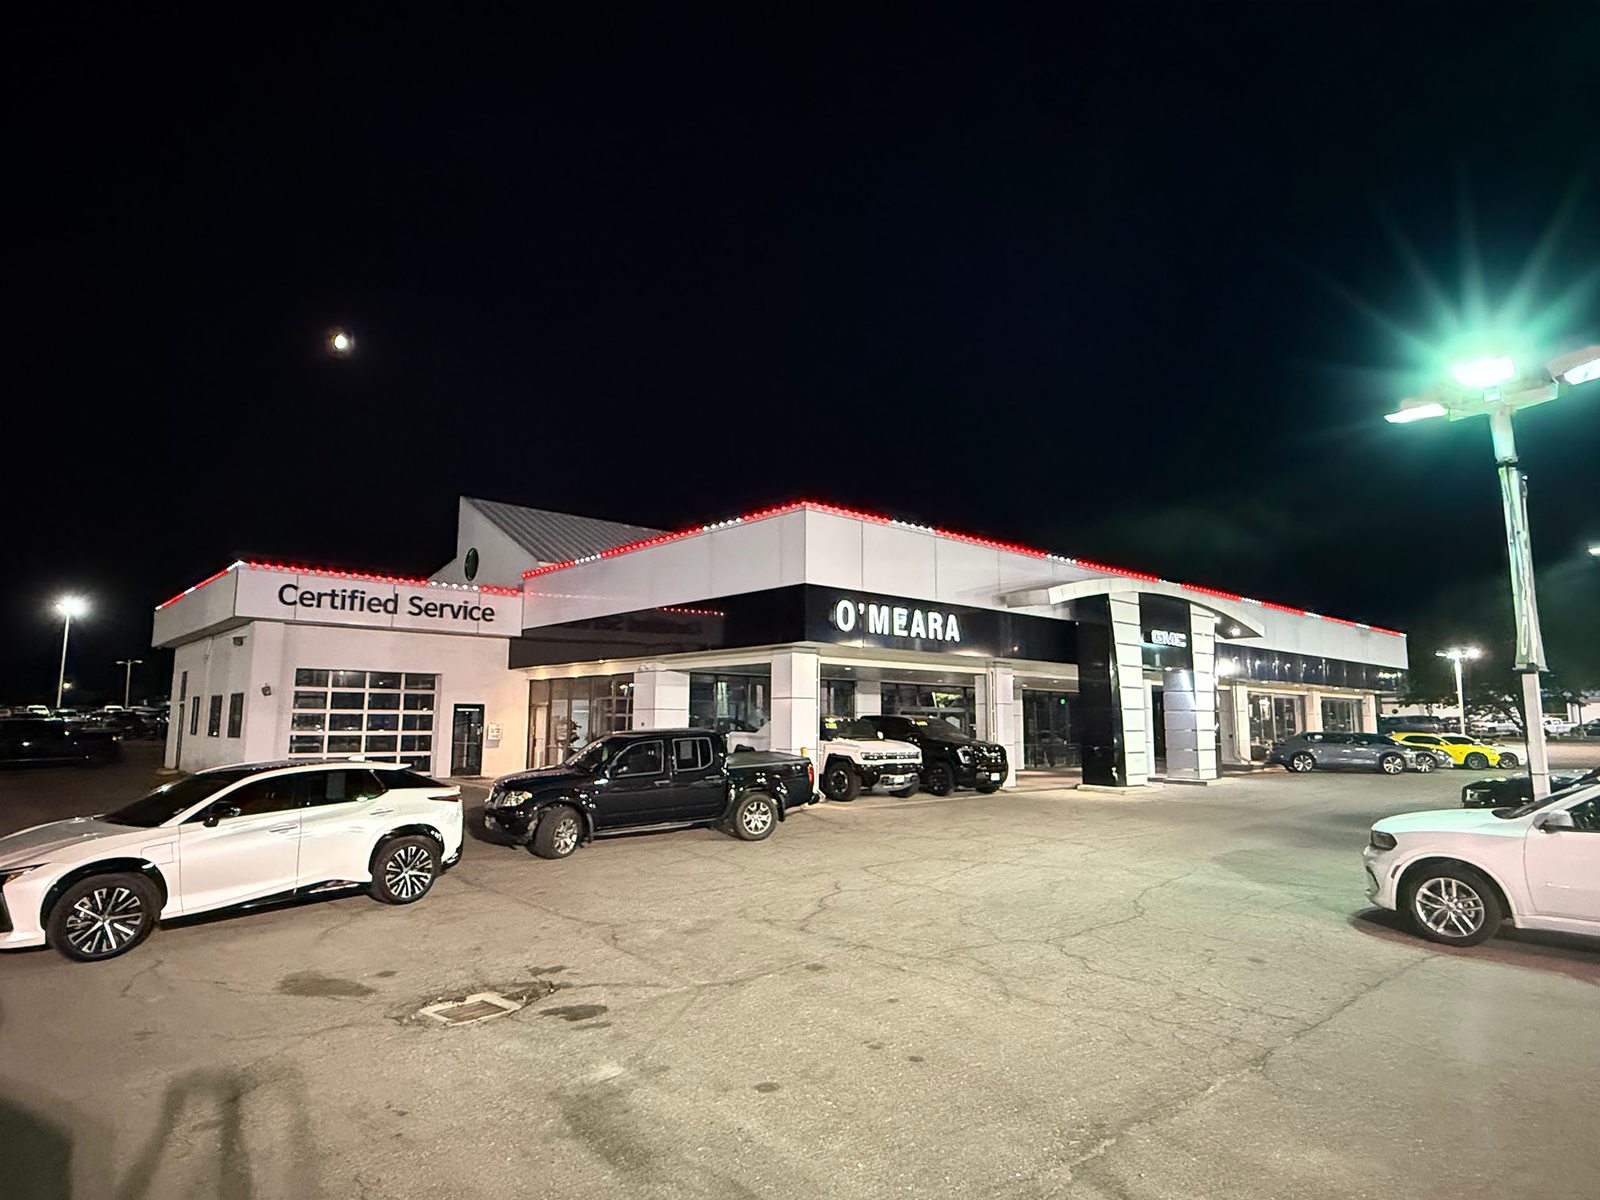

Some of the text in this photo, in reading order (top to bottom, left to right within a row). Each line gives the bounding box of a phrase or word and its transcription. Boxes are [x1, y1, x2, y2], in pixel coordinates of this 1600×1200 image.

[278, 583, 495, 622] Certified Service
[836, 599, 960, 642] O'MEARA
[1151, 629, 1187, 648] GMC
